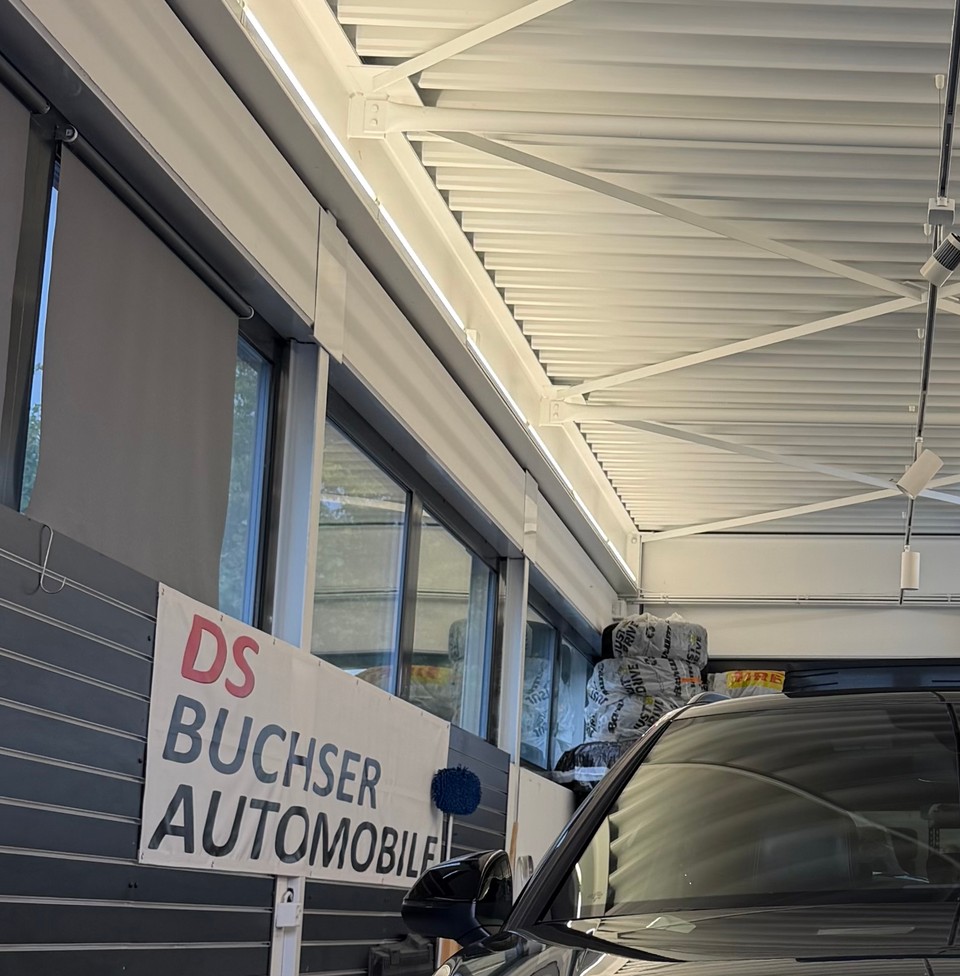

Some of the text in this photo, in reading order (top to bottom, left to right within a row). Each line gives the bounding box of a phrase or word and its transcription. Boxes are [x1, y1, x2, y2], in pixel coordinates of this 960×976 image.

[181, 614, 259, 698] DS
[162, 694, 382, 809] BUCHSER
[148, 783, 438, 878] AUTOMOBILE
